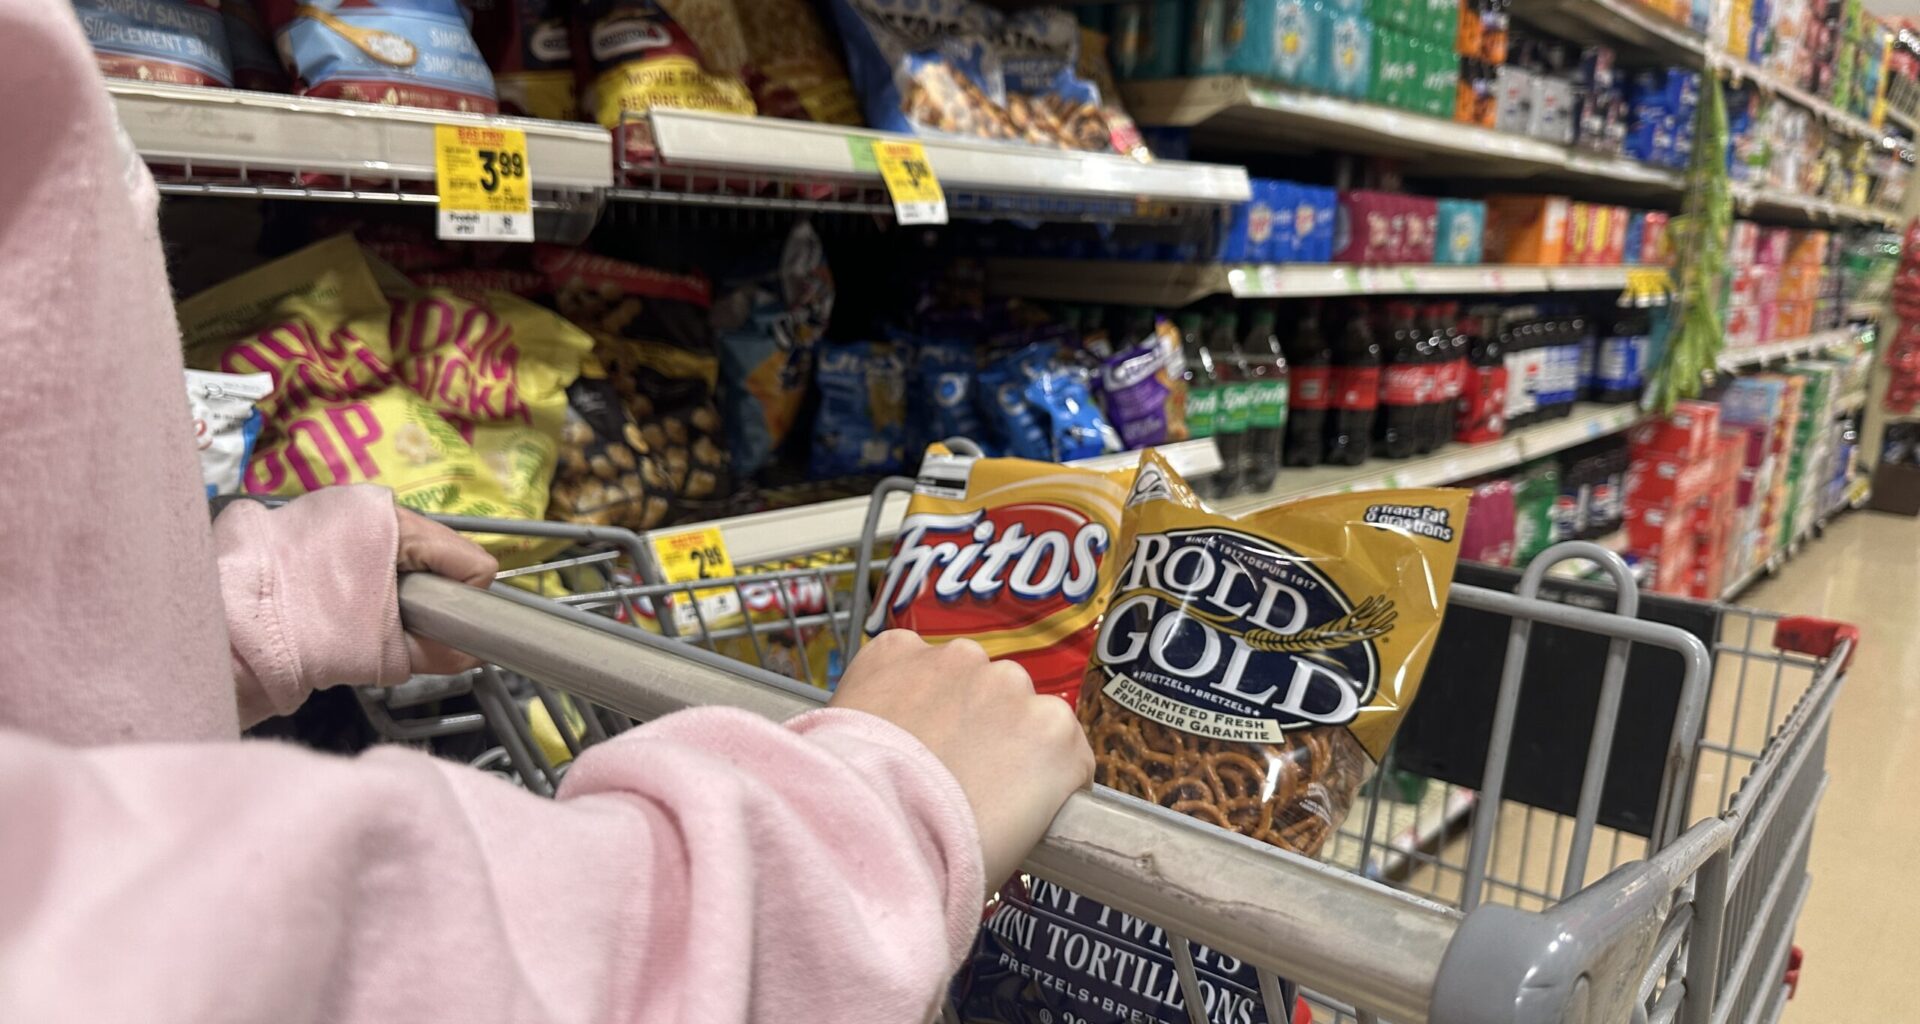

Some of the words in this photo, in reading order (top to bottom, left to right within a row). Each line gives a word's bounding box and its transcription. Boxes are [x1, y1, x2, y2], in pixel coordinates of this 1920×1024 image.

[83, 16, 184, 52] SIMPLEMENT
[243, 402, 384, 496] POP
[1413, 519, 1452, 541] trans
[1422, 507, 1447, 524] Fat
[865, 508, 1110, 637] Fritos
[1124, 534, 1310, 636] ROLD
[1291, 574, 1318, 590] 1917
[1097, 595, 1361, 725] GOLD
[1120, 679, 1208, 720] GUARANTEED
[1214, 715, 1264, 729] FRESH
[1190, 720, 1270, 740] GARANTIE
[1030, 877, 1079, 915] INY
[1097, 905, 1242, 974] TWITS
[985, 902, 1038, 951] MINI
[1046, 922, 1255, 1024] TORTILLONS
[1000, 953, 1089, 1002] PRETZELS
[1101, 997, 1170, 1024] BRET
